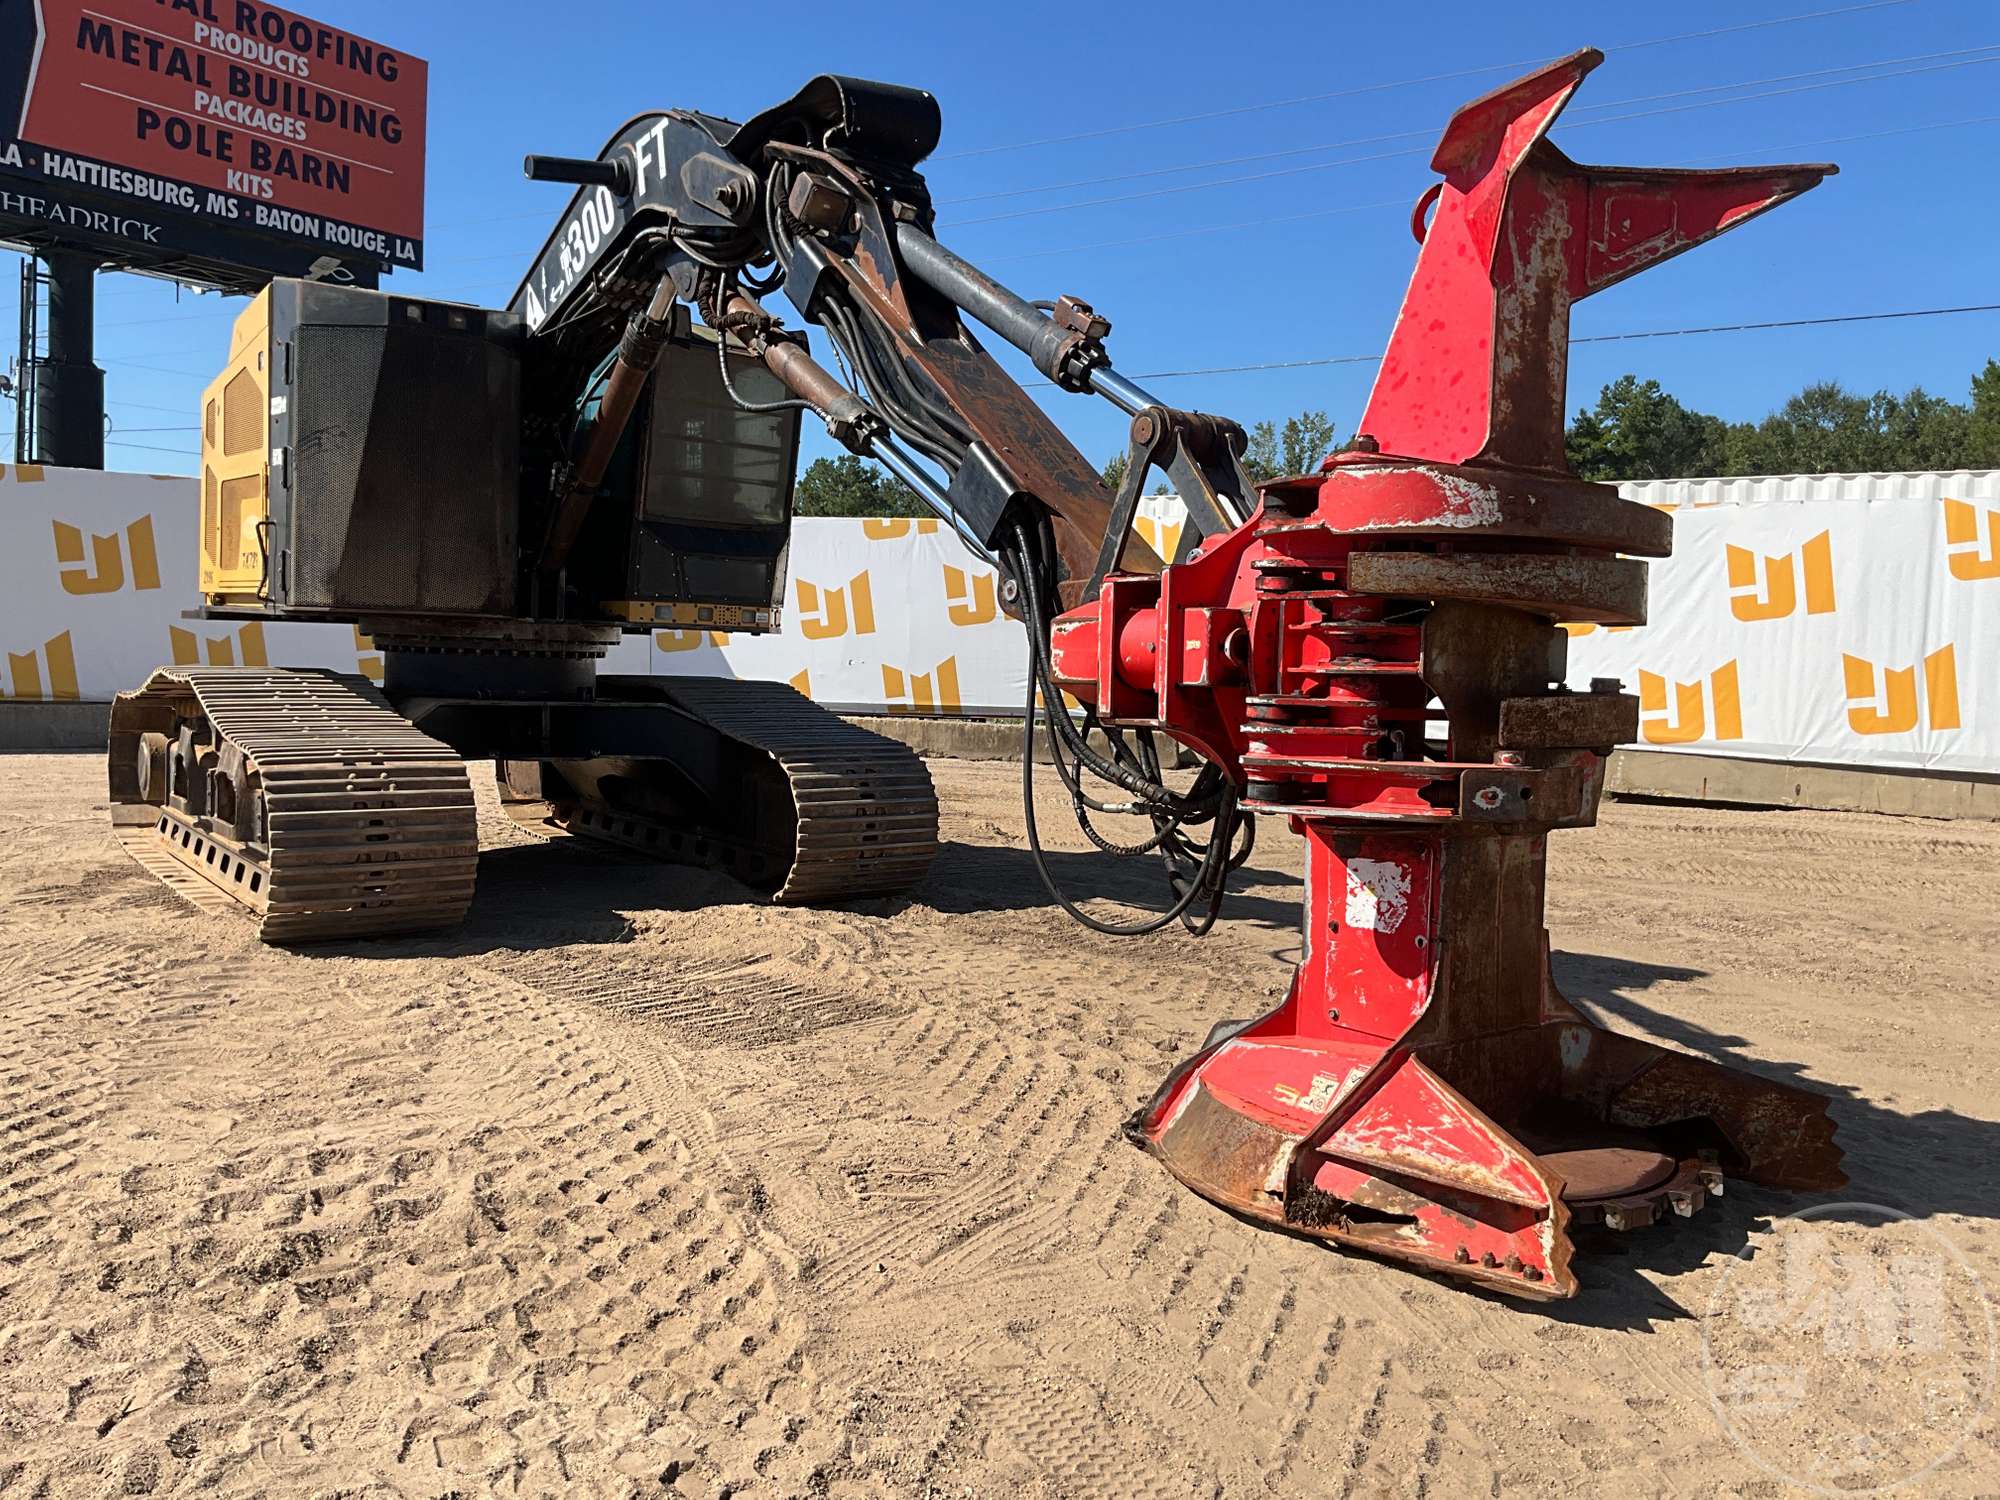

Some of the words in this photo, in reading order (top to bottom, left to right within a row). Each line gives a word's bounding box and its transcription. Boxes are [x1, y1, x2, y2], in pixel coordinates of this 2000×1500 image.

[77, 17, 212, 88] METAL
[229, 65, 402, 144] BUILDING
[194, 21, 310, 77] PRODUCTS
[236, 0, 399, 82] ROOFING
[137, 107, 233, 163] POLE
[251, 139, 350, 194] BARN
[194, 90, 307, 141] PACKAGES
[0, 191, 162, 243] HEADRICK
[43, 152, 200, 213] HATTIESBURG,
[206, 192, 239, 219] MS
[255, 204, 320, 238] BATON
[325, 221, 391, 258] ROUGE,
[395, 239, 416, 261] LA
[227, 169, 274, 199] KITS
[567, 185, 615, 273] 300
[634, 117, 669, 197] FT
